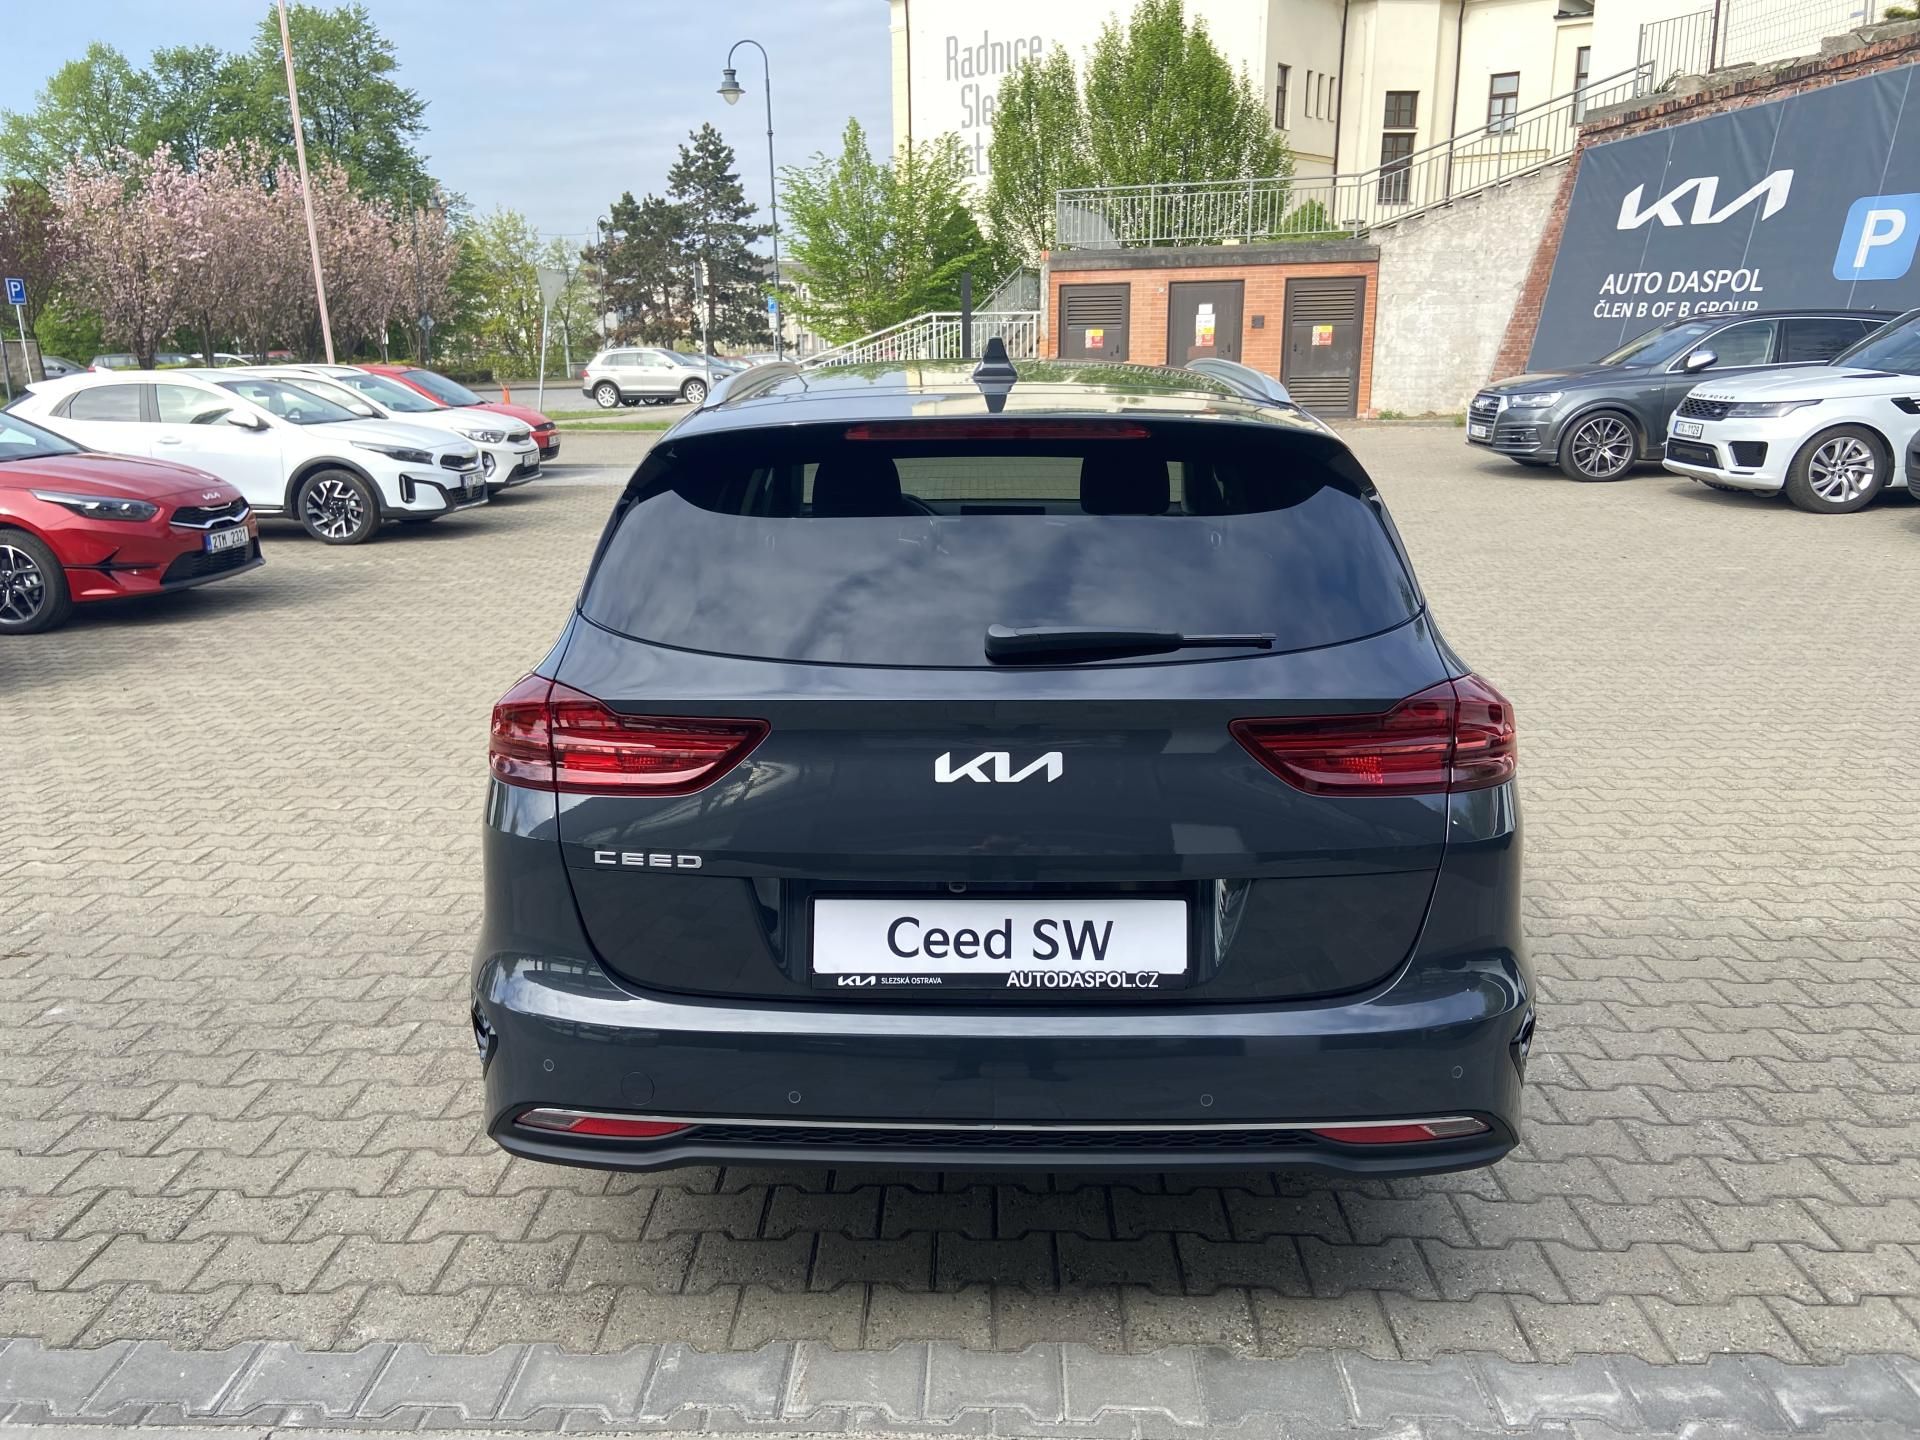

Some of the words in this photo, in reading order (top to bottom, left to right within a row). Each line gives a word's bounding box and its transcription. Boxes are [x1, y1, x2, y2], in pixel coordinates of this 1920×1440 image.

[1617, 169, 1794, 230] KIA
[1853, 209, 1906, 268] P
[10, 281, 21, 297] P
[1599, 271, 1663, 295] AUTO
[1667, 268, 1763, 293] DASPOL
[1593, 300, 1634, 318] ČLEN
[1636, 302, 1649, 317] B
[1651, 301, 1676, 318] OF
[1678, 302, 1691, 317] B
[212, 533, 228, 549] 2TM
[230, 528, 248, 544] 2321
[934, 751, 1064, 783] KIA
[594, 850, 703, 869] CEED
[887, 916, 1012, 960] Ceed
[1032, 918, 1114, 960] SW
[837, 975, 876, 986] KIA
[881, 976, 910, 985] SLEZSKÁ
[911, 976, 942, 985] OSTRAVA
[1006, 970, 1160, 988] AUTODASPOL.CZ
